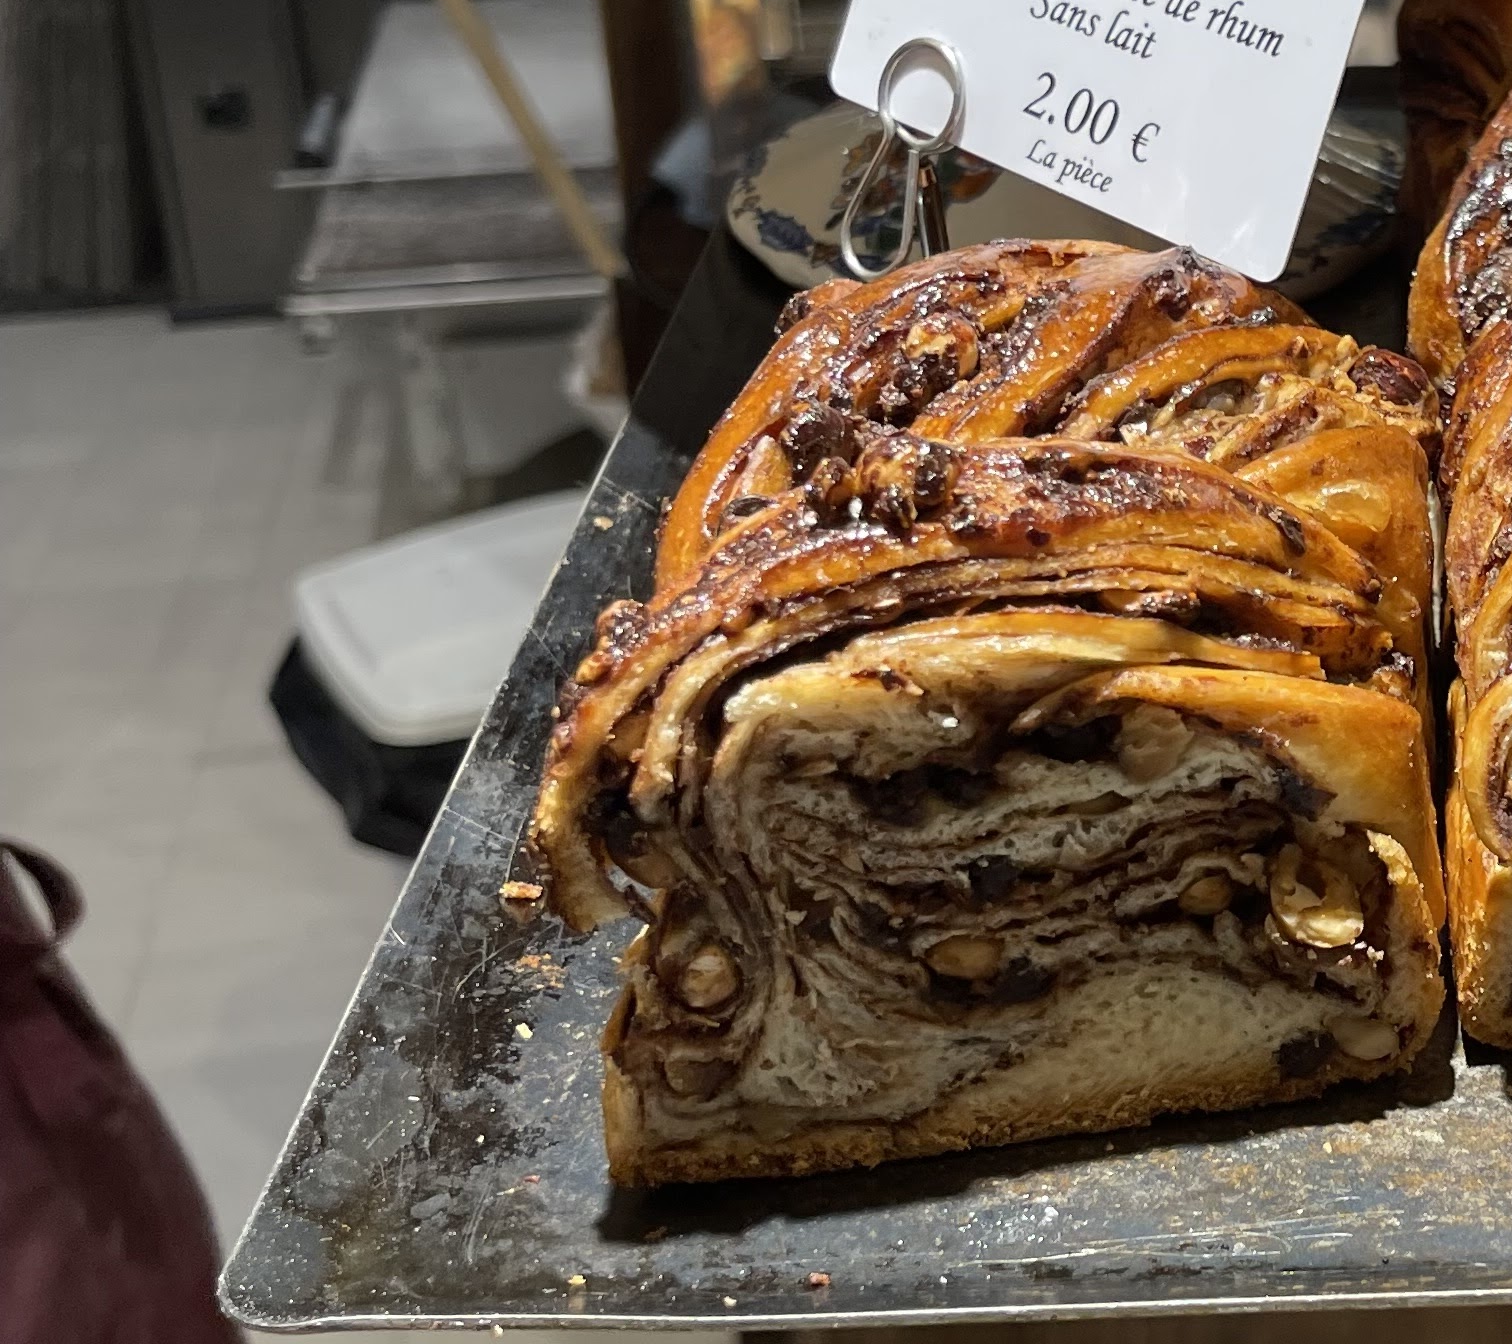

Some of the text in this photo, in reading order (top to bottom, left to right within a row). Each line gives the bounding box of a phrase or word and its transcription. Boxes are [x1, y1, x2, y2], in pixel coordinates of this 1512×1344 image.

[1104, 9, 1159, 60] lait
[1204, 0, 1286, 59] rhum
[1022, 71, 1161, 163] 2.00 €
[1026, 138, 1114, 194] La pièce
